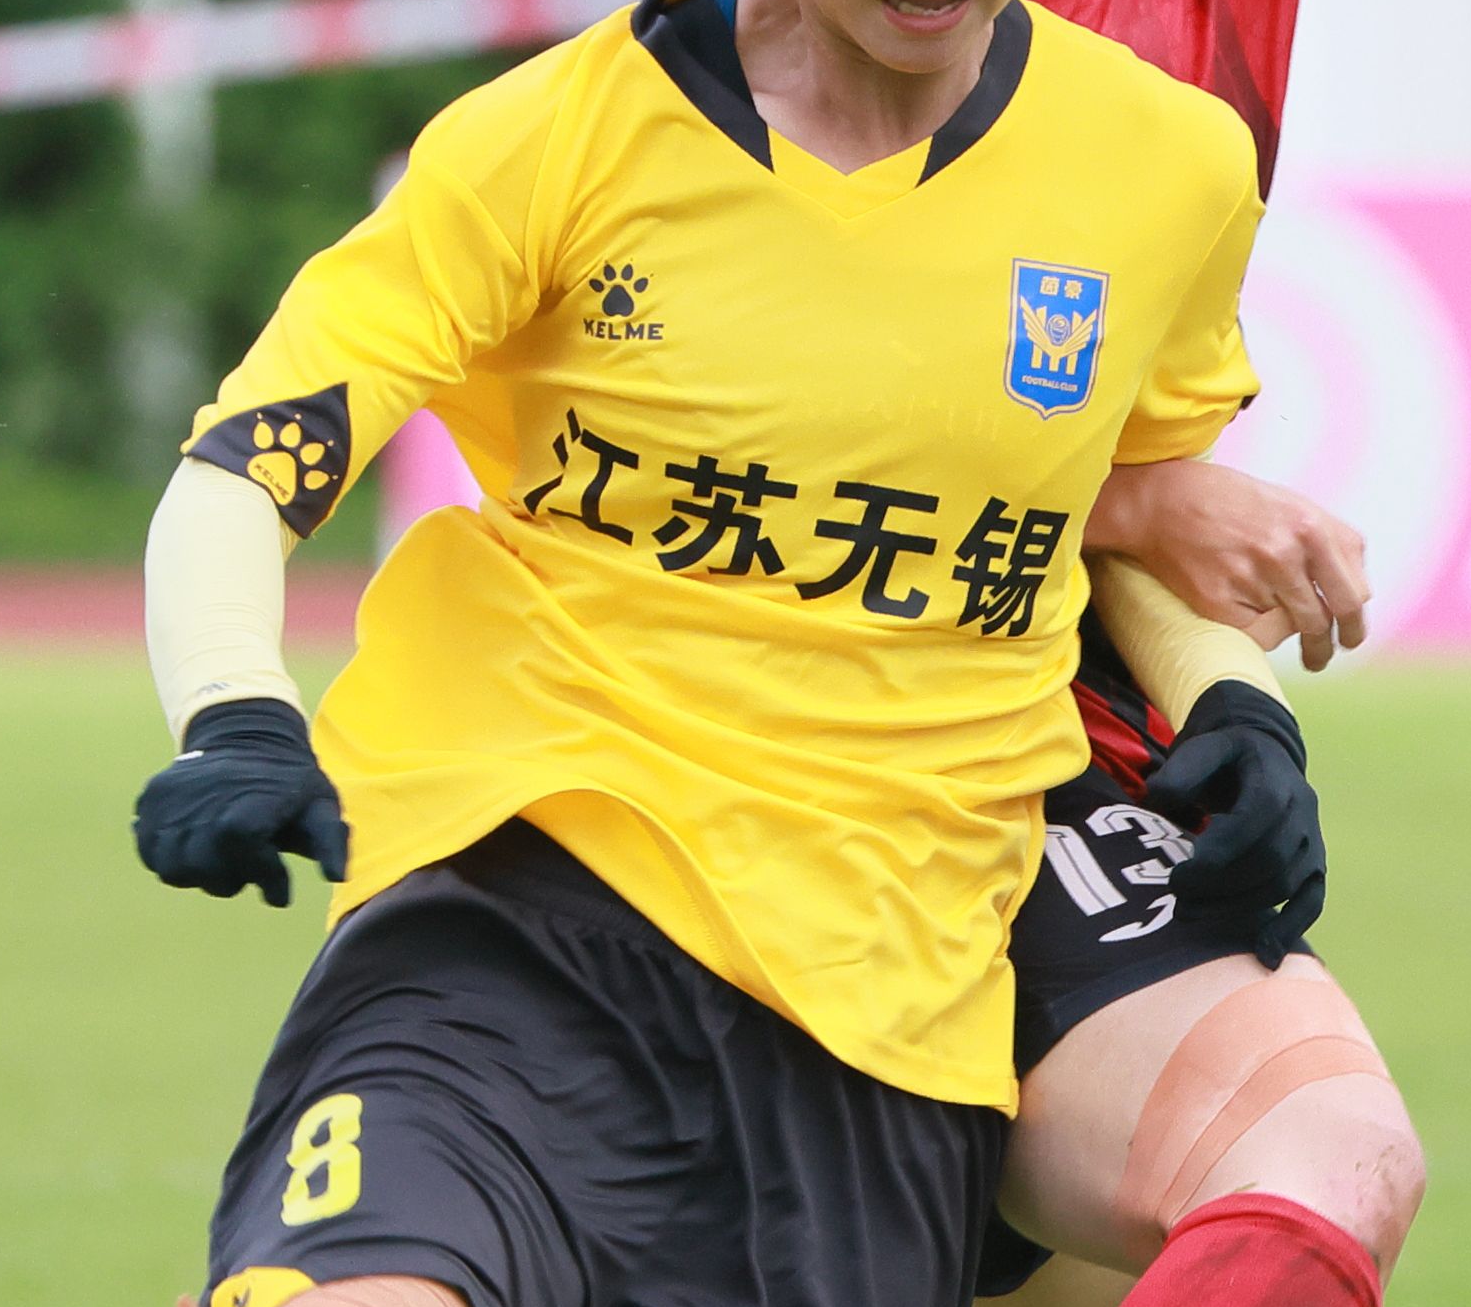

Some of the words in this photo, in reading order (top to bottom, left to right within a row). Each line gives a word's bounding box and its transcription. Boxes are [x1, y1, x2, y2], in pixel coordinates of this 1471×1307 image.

[583, 318, 664, 340] KELME
[523, 407, 1070, 637] 江苏无锡
[1045, 803, 1196, 917] 13
[280, 1093, 362, 1226] 8
